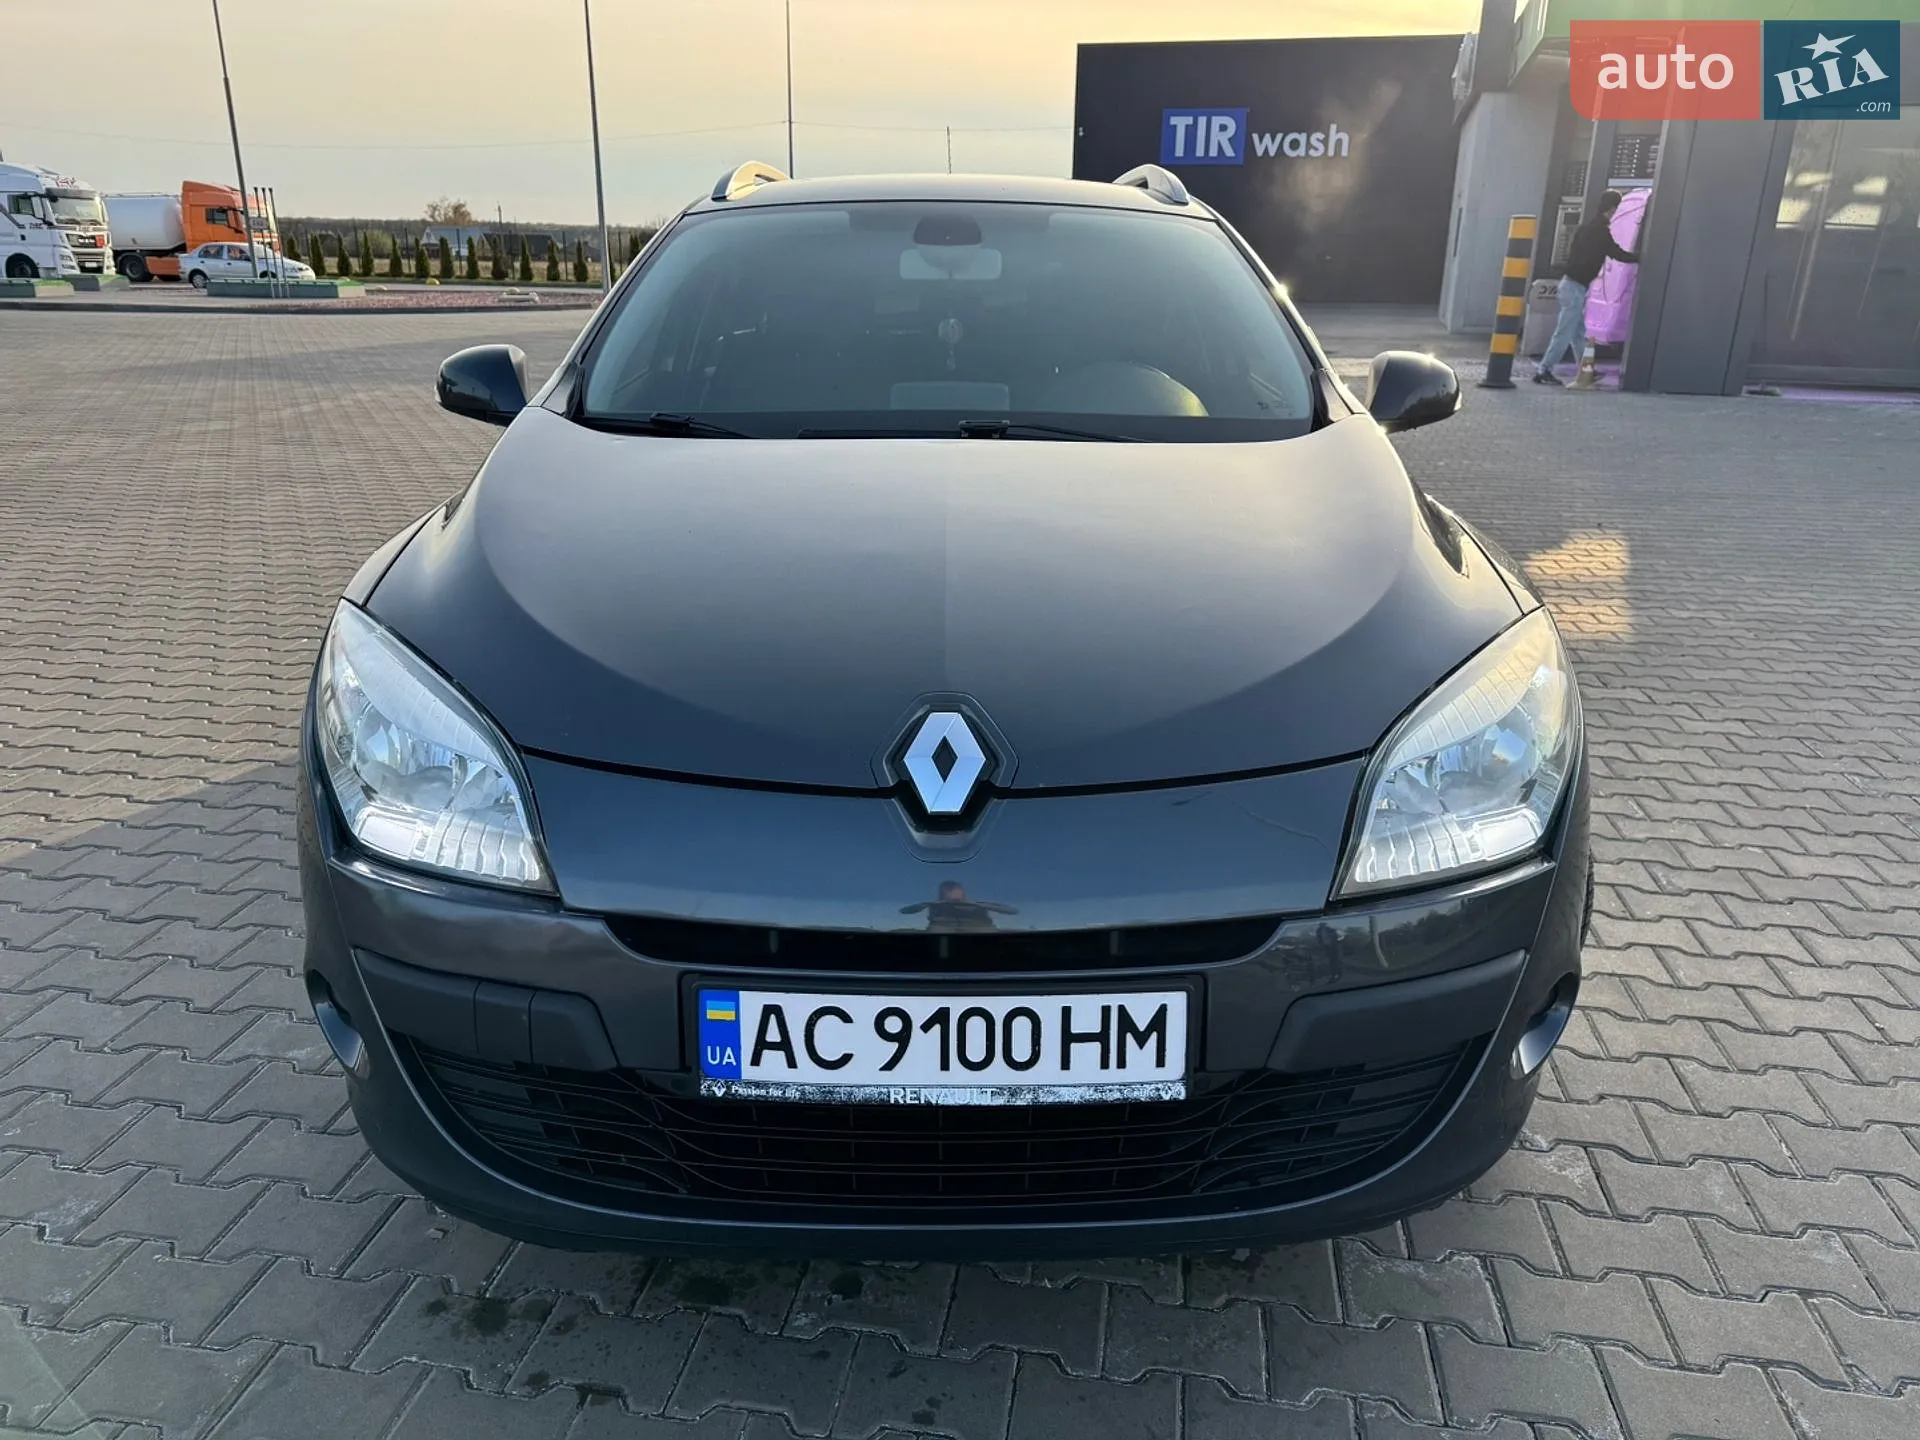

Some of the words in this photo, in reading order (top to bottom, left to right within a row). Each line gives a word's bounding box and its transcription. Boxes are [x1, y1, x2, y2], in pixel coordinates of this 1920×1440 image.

[1169, 115, 1237, 157] TIR
[1252, 123, 1350, 157] wash
[750, 1004, 854, 1071] AC
[874, 1006, 1042, 1071] 9100
[1060, 1003, 1168, 1071] HM
[707, 1045, 737, 1066] UA
[889, 1087, 1000, 1105] RENAULT
